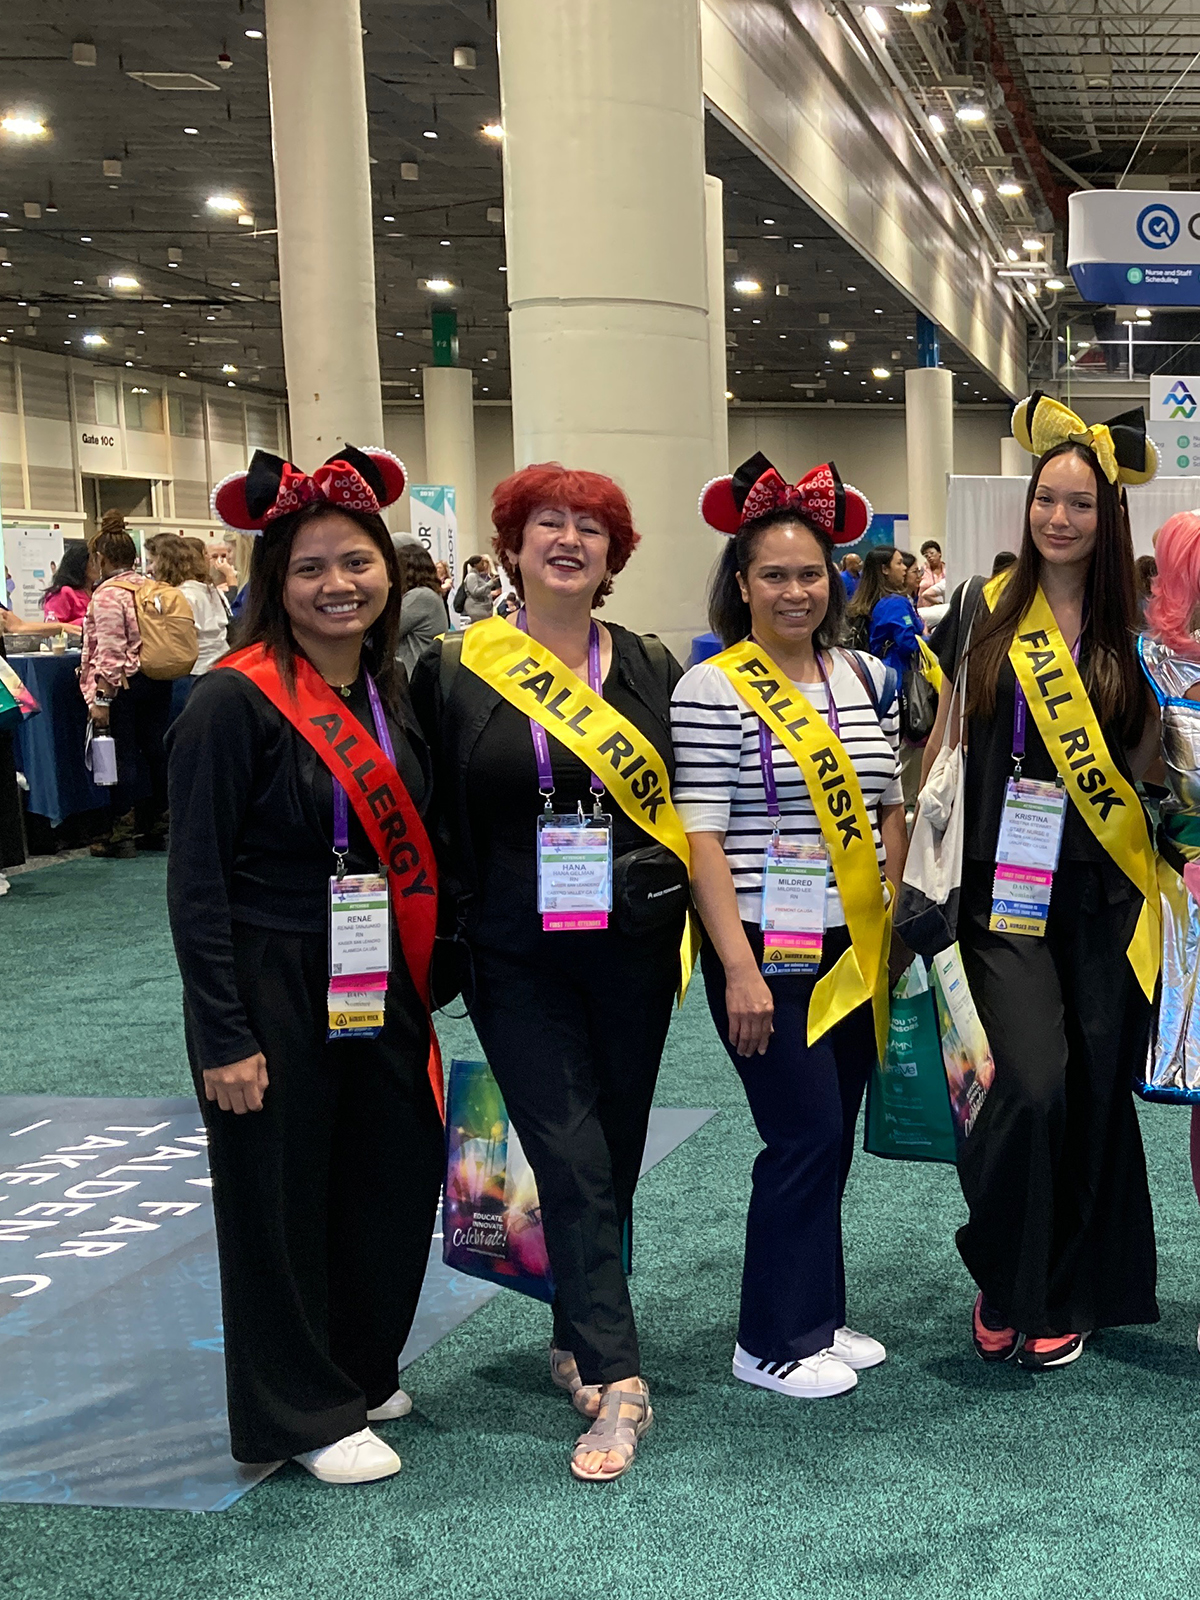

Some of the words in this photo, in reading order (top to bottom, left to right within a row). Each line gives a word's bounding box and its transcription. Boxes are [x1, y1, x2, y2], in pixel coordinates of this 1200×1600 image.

[82, 433, 99, 445] Gate
[506, 656, 593, 737] FALL
[597, 731, 666, 825] RISK
[735, 658, 810, 742] FALL
[809, 747, 863, 850] RISK
[1019, 629, 1072, 720] FALL
[1058, 726, 1126, 822] RISK
[309, 713, 436, 898] ALLERGY
[1015, 813, 1048, 823] KRISTINA
[347, 915, 372, 923] RENAE
[0, 1121, 171, 1185] TAKE
[35, 1201, 202, 1259] FAR
